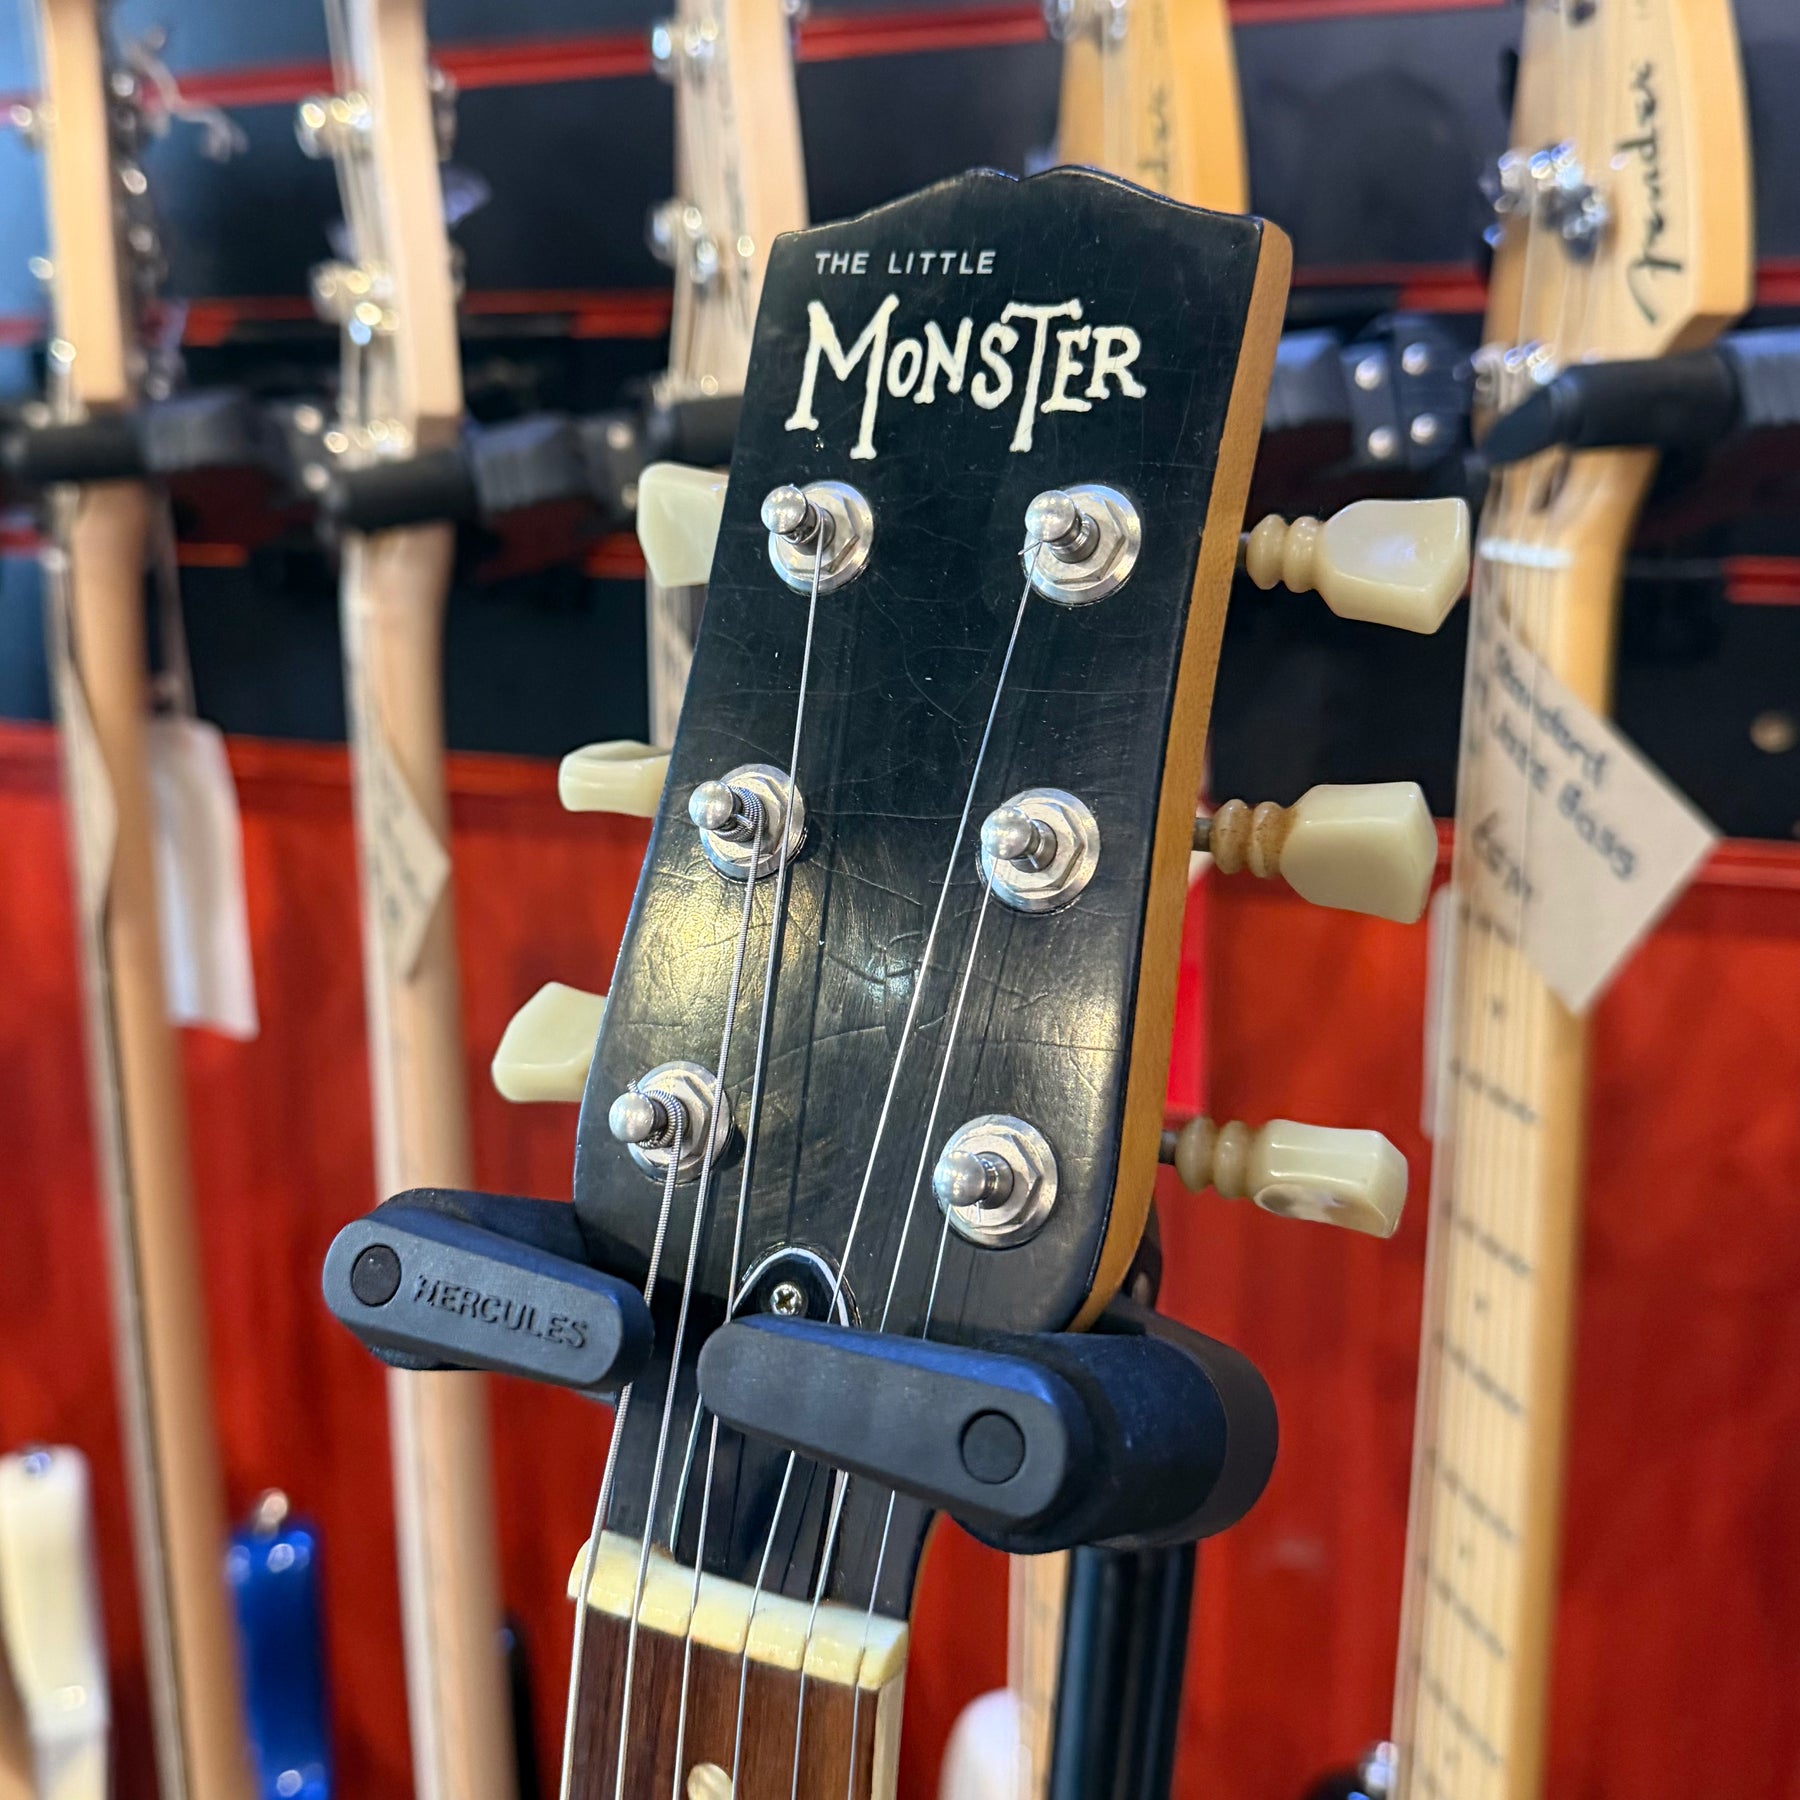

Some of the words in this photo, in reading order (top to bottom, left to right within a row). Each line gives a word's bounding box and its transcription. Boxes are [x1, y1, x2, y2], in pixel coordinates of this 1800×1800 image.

[1614, 60, 1685, 325] Fender
[815, 250, 870, 275] THE
[887, 250, 996, 275] LITTLE
[413, 1274, 589, 1349] HERCULES
